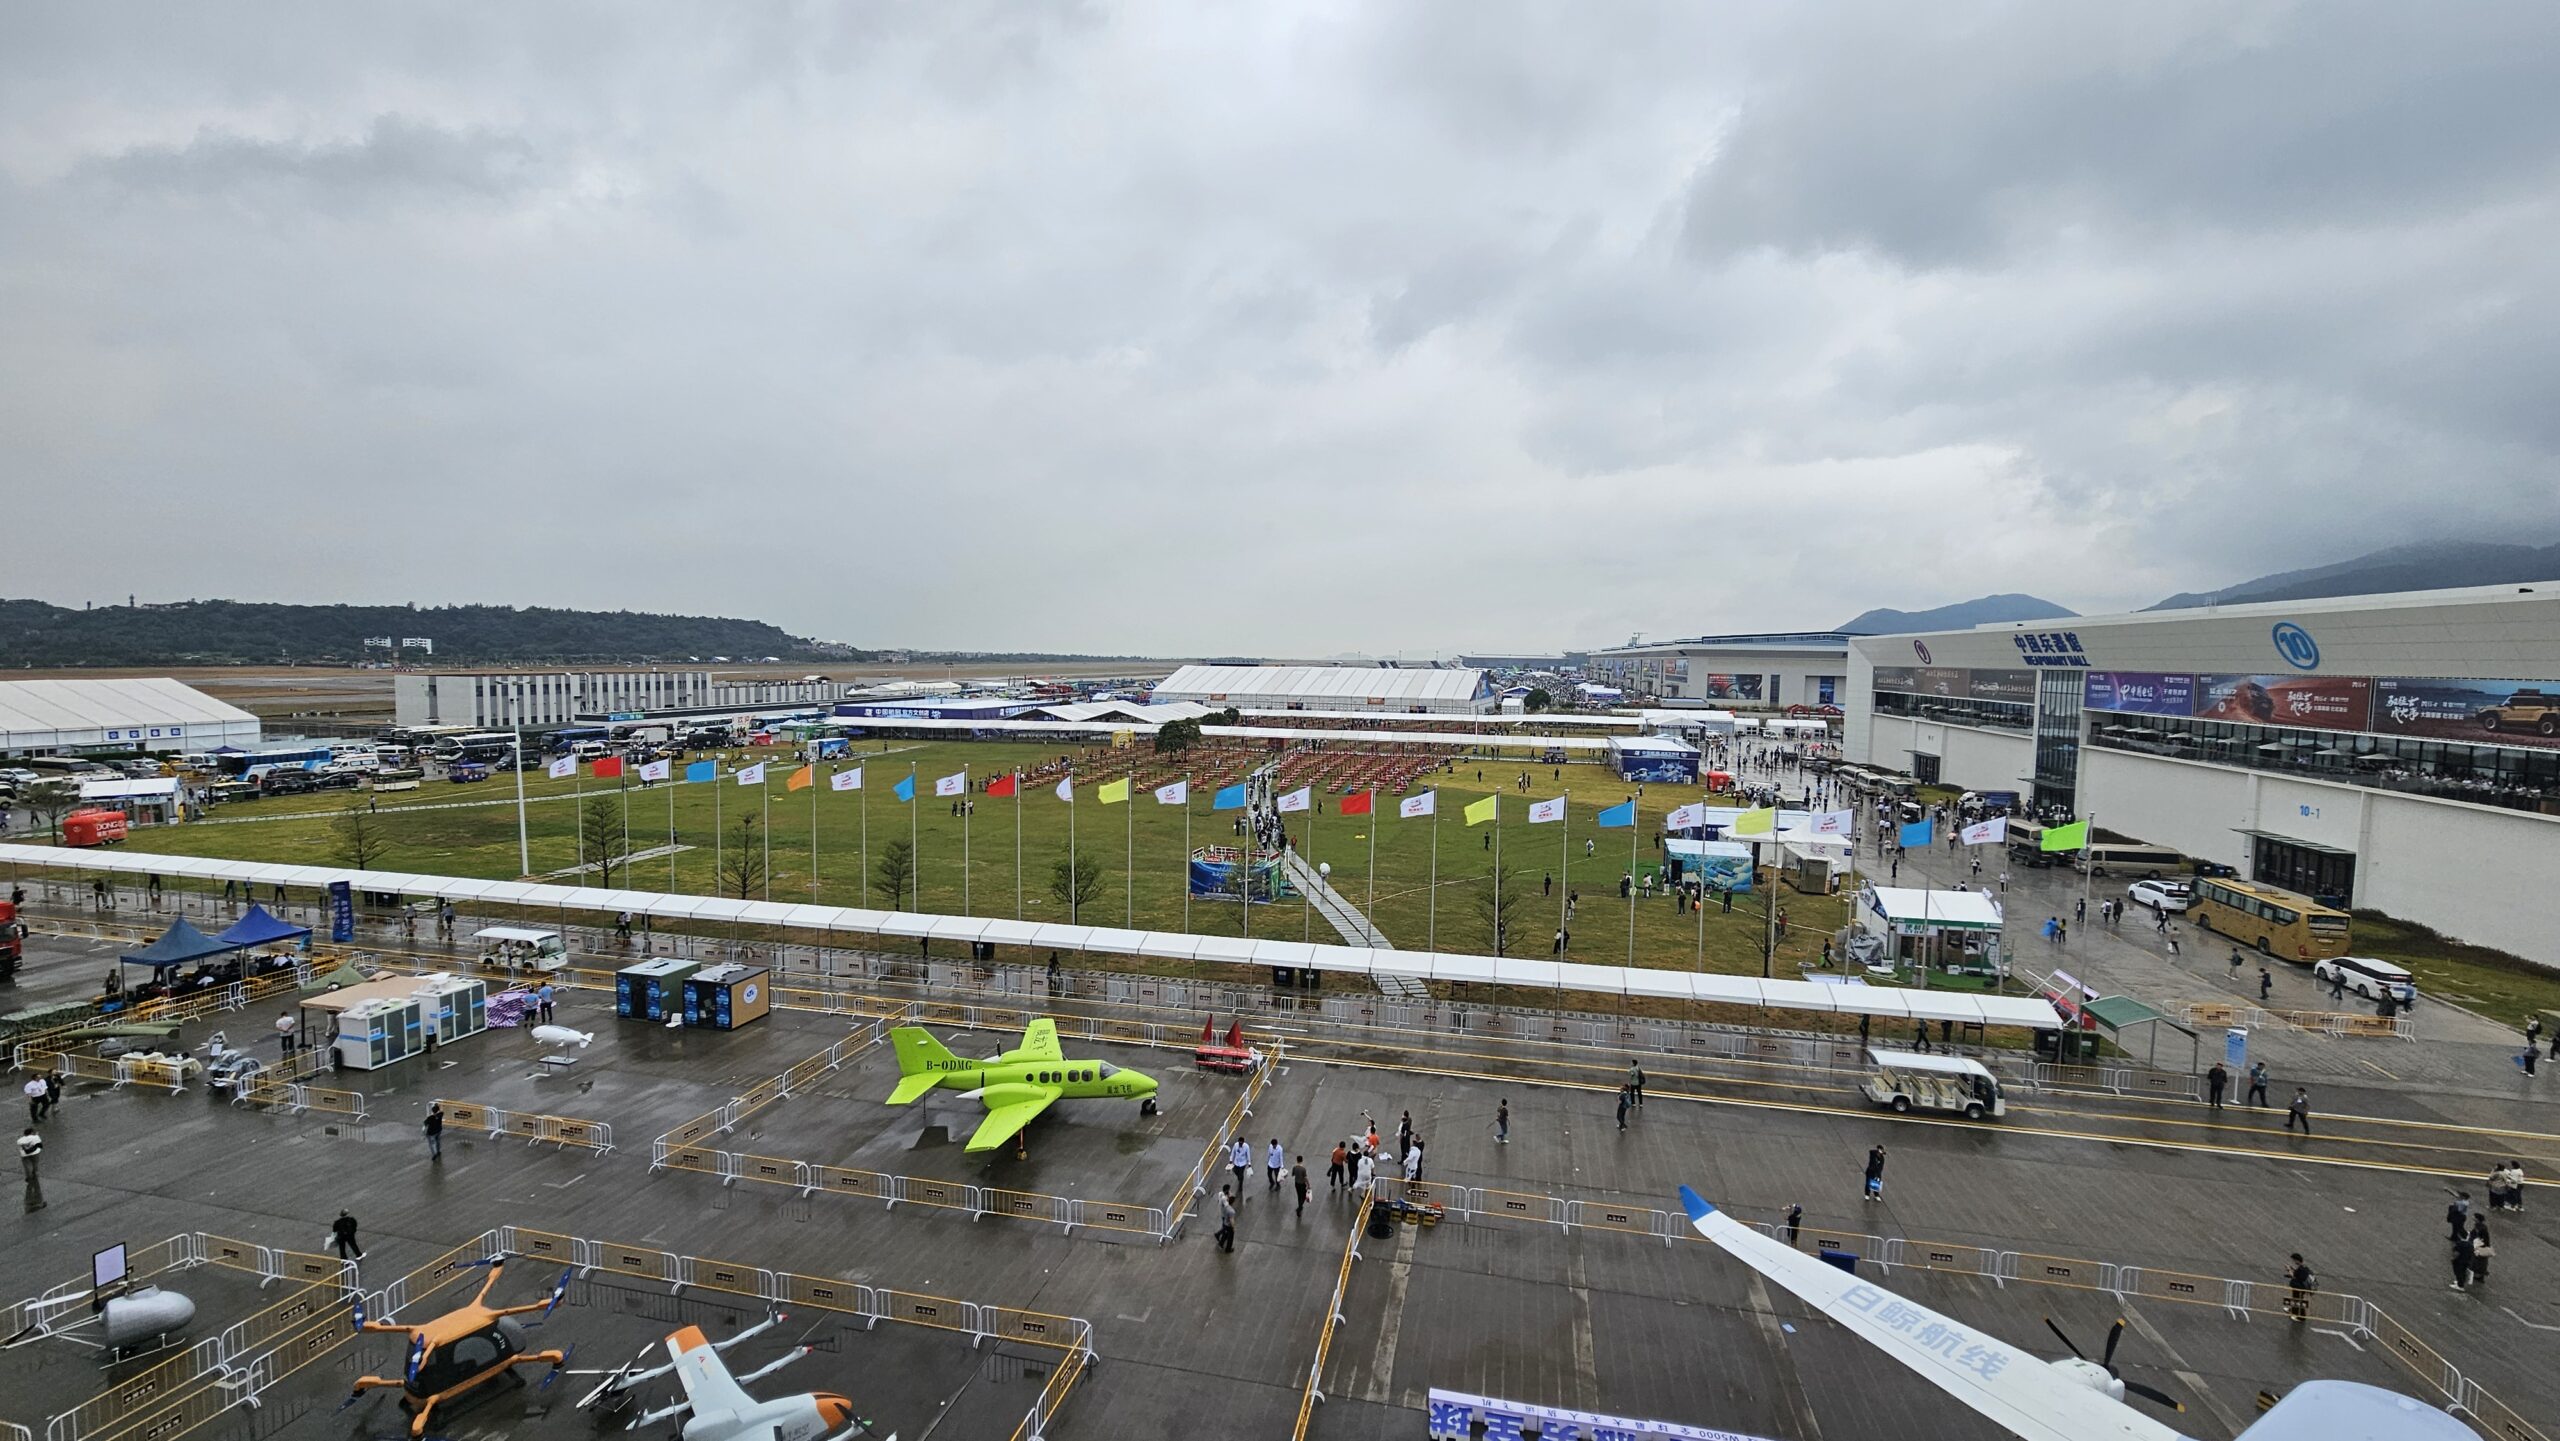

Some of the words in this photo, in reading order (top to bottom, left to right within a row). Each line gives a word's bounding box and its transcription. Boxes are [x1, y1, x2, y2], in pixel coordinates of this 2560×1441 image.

[2013, 631, 2084, 654] 中国兵器馆
[2280, 632, 2313, 660] 10
[2300, 805, 2320, 819] 10-1
[1840, 1284, 2010, 1382] 白鲸航线
